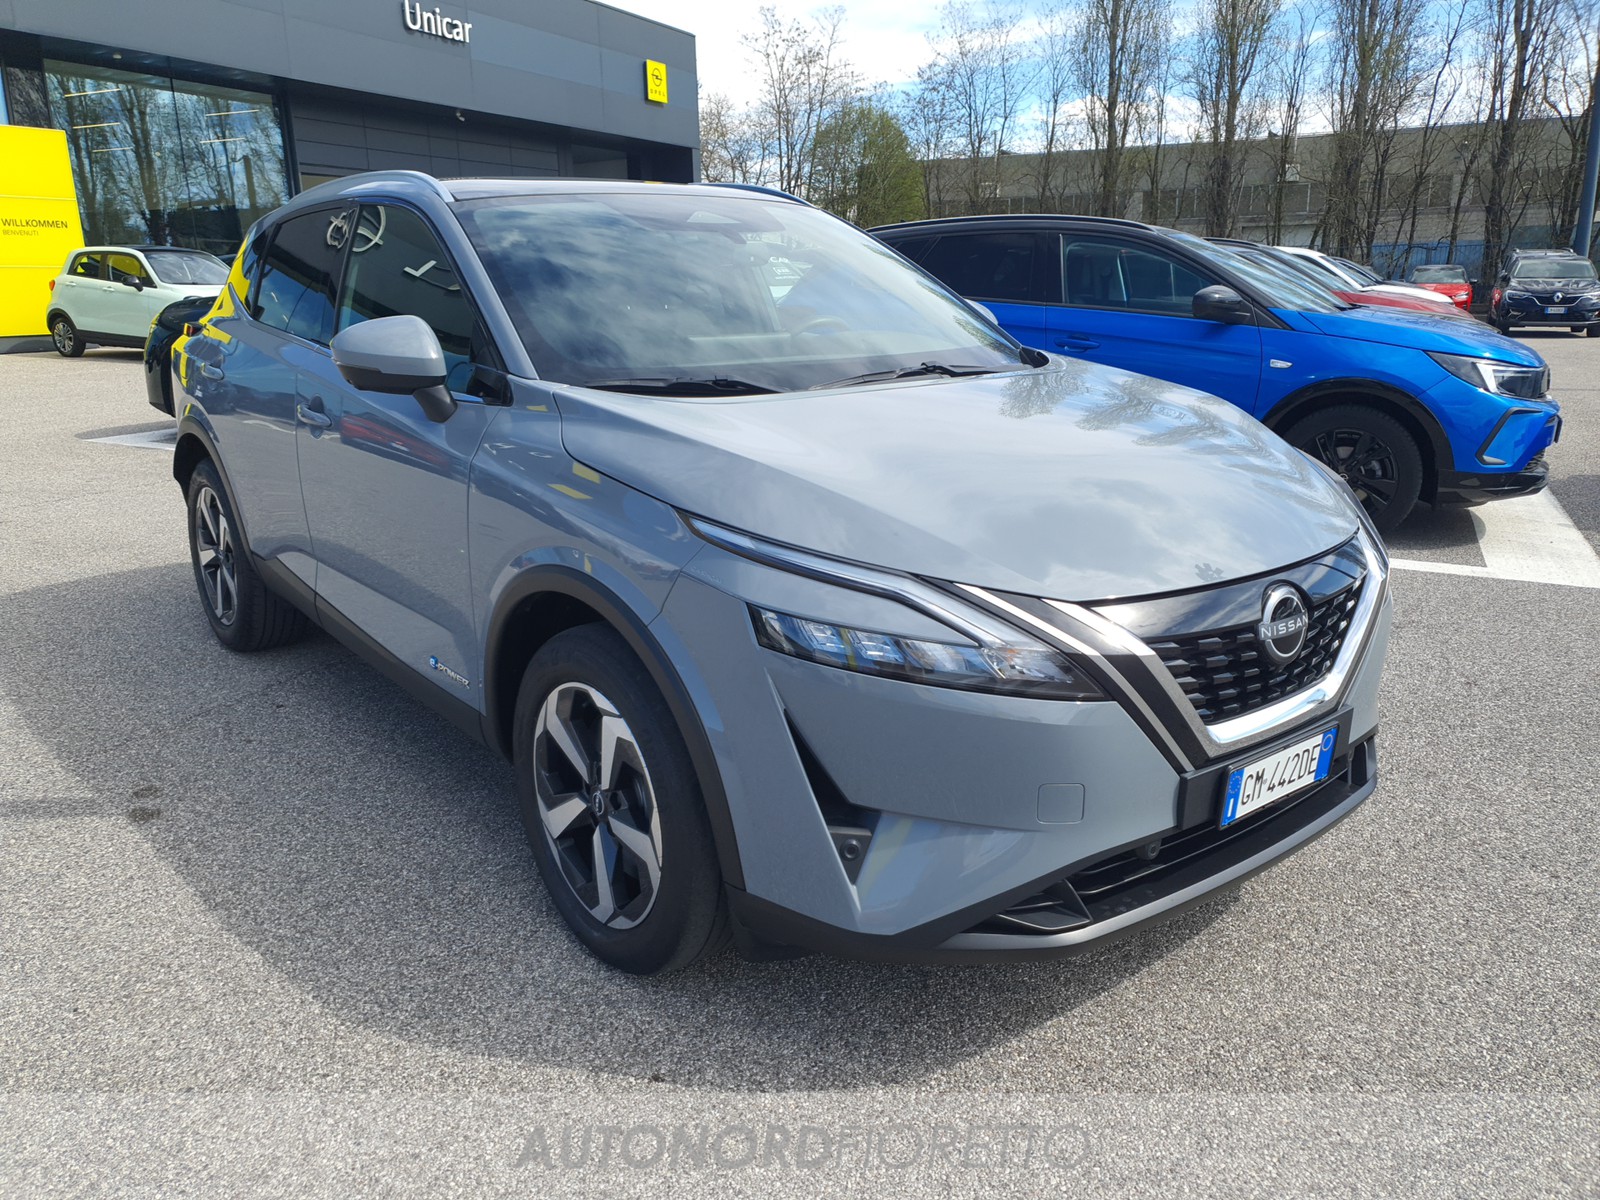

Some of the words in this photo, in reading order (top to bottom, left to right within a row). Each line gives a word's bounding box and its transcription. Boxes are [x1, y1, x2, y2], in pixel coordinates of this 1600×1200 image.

[404, 0, 472, 43] Unicar
[1, 218, 68, 229] WILLKOMMEN
[1261, 614, 1308, 638] NISSAN
